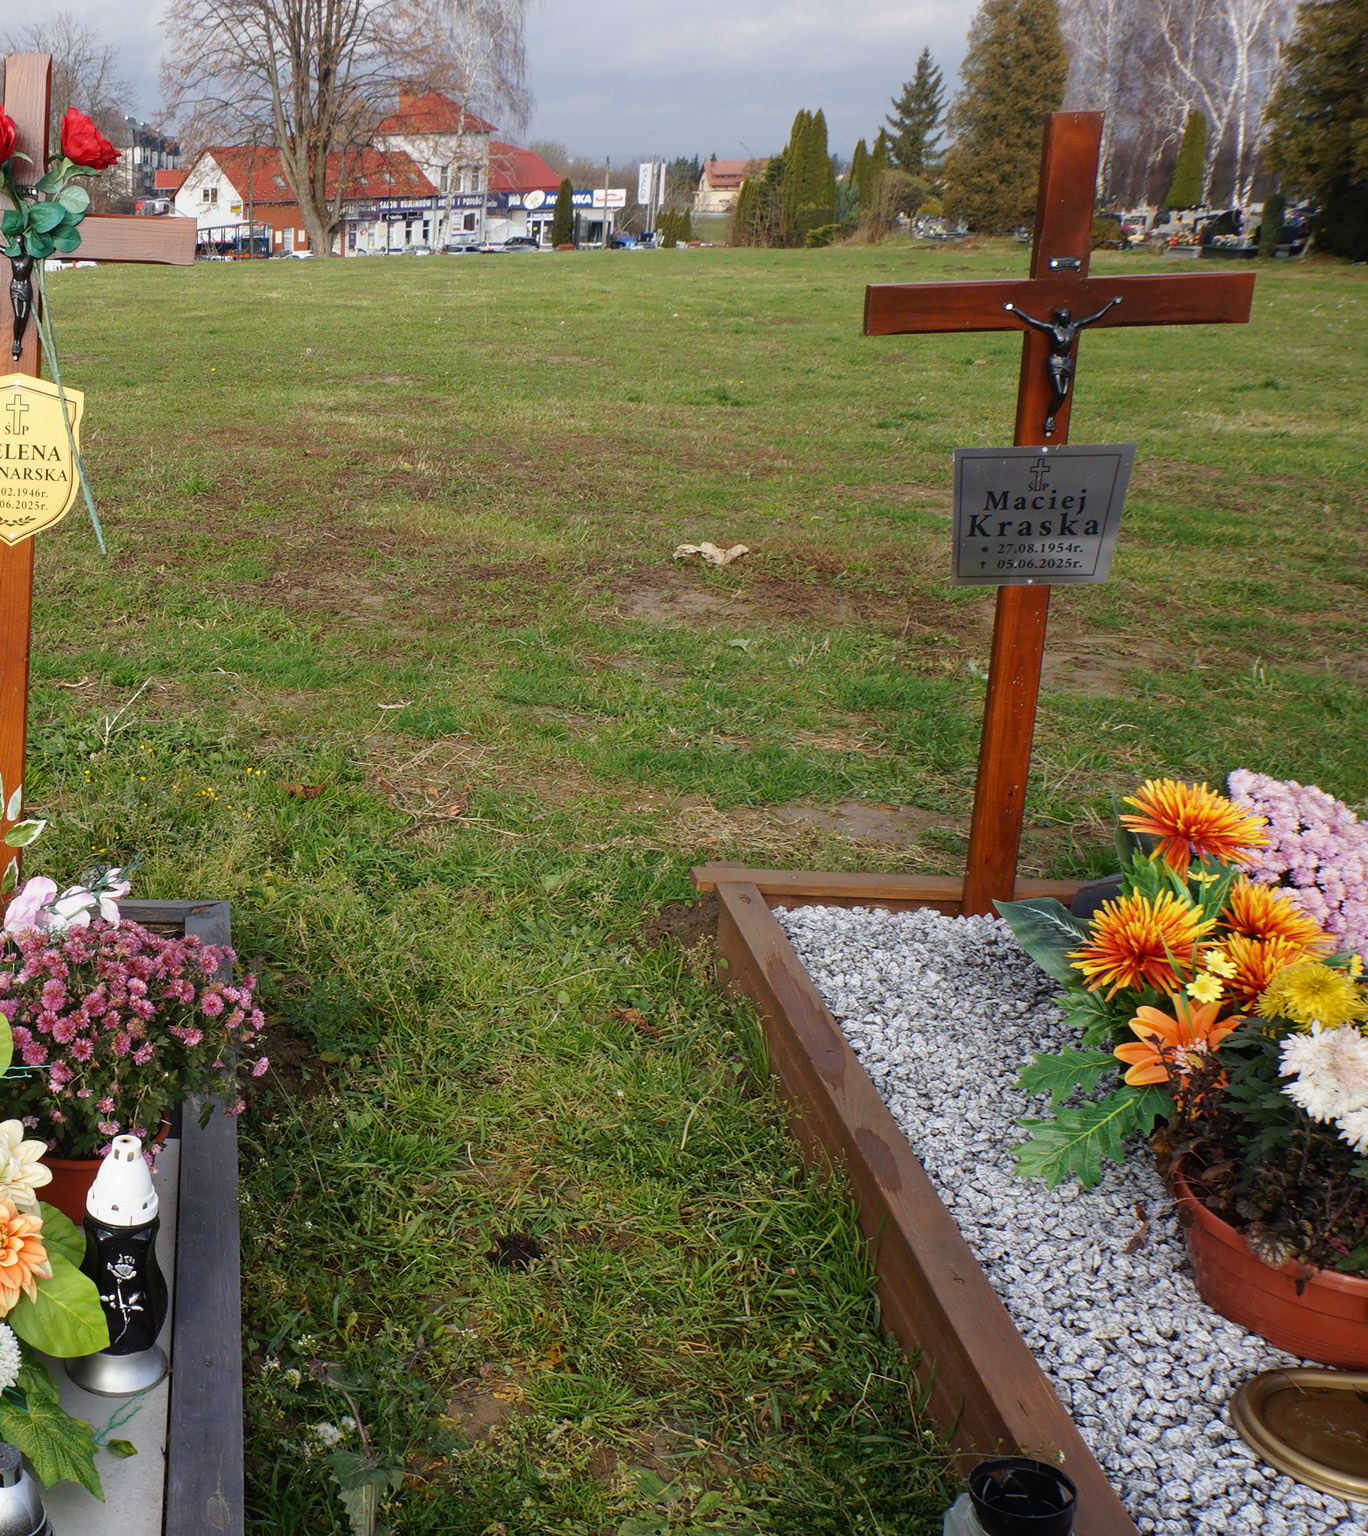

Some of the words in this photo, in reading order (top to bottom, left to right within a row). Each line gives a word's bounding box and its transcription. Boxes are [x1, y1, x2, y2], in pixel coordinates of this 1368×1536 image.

[546, 194, 592, 204] MWKA
[983, 488, 1088, 515] Maciej
[966, 512, 1100, 538] Kraska
[997, 542, 1084, 554] 27.08.1954r.
[996, 558, 1083, 570] 05.06.2025r.
